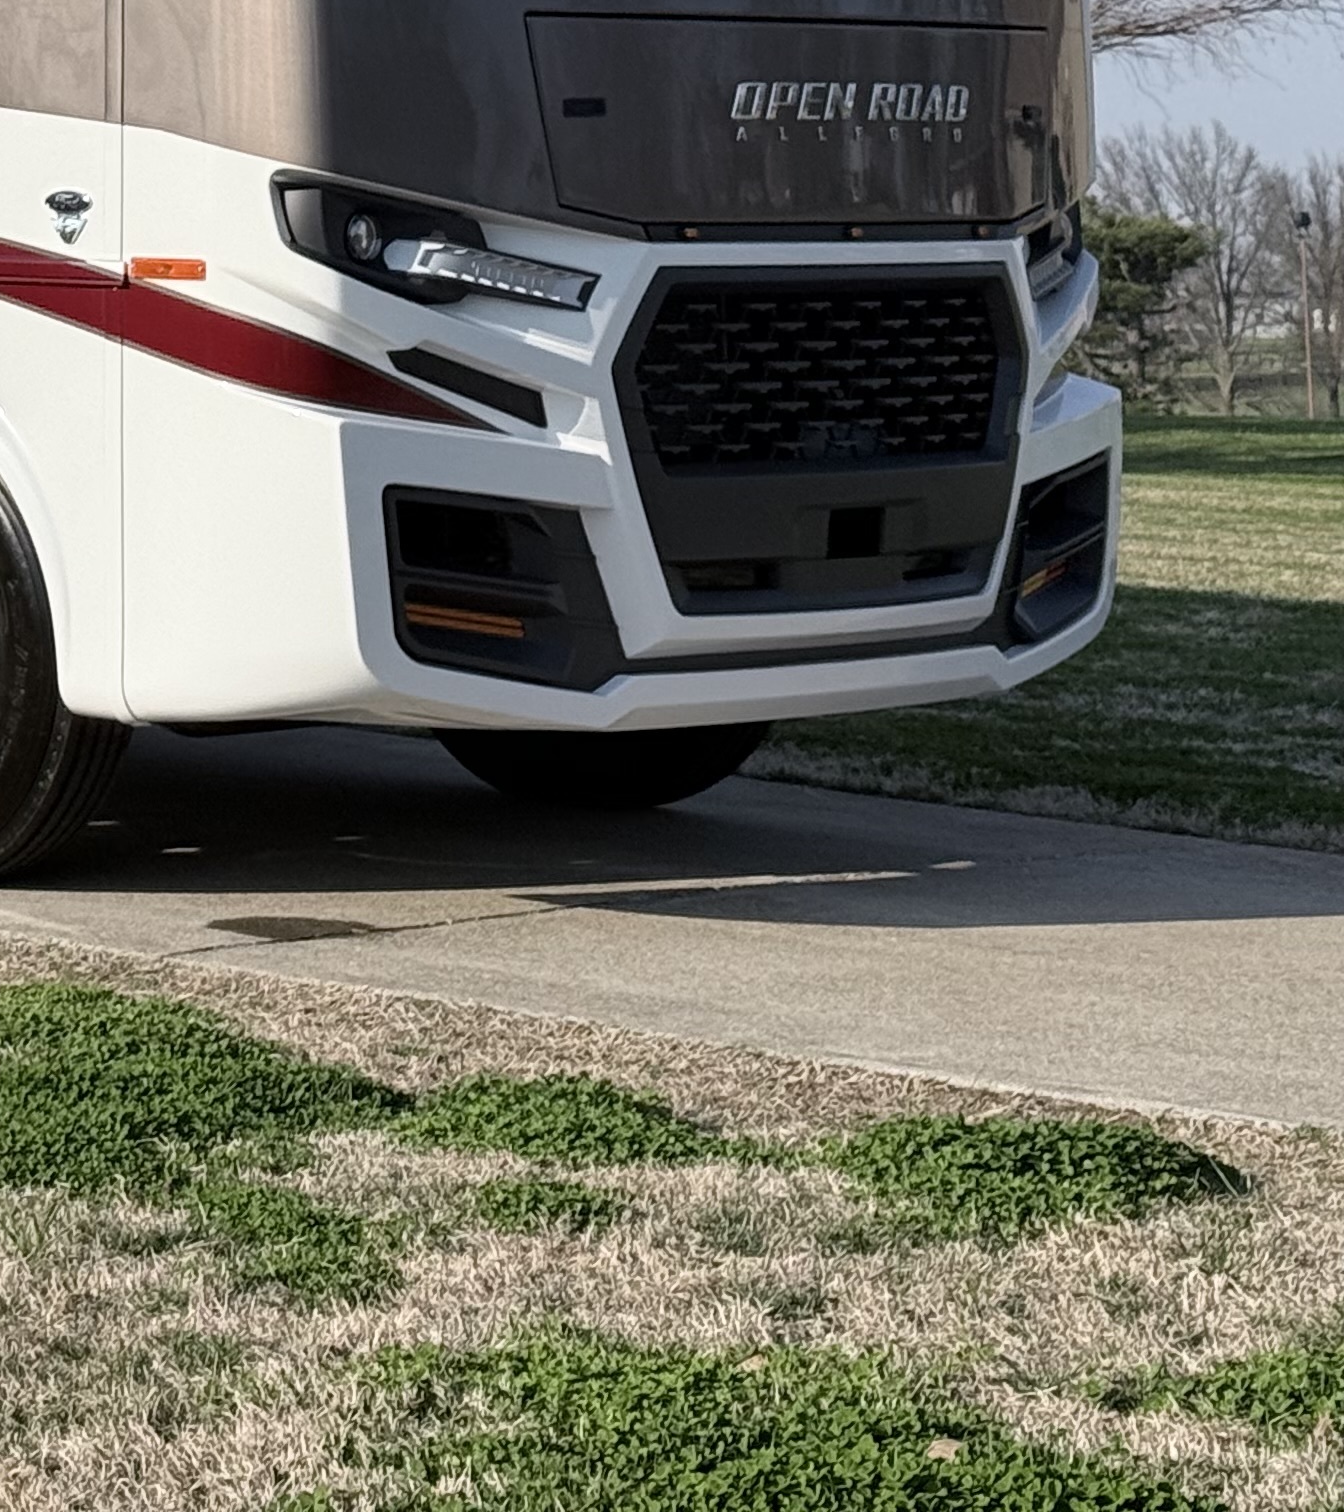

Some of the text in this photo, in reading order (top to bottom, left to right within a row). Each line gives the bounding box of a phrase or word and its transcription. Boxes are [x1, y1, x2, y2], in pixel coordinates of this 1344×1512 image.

[730, 81, 969, 122] OPEN ROAD
[735, 125, 962, 144] ALLEGRO
